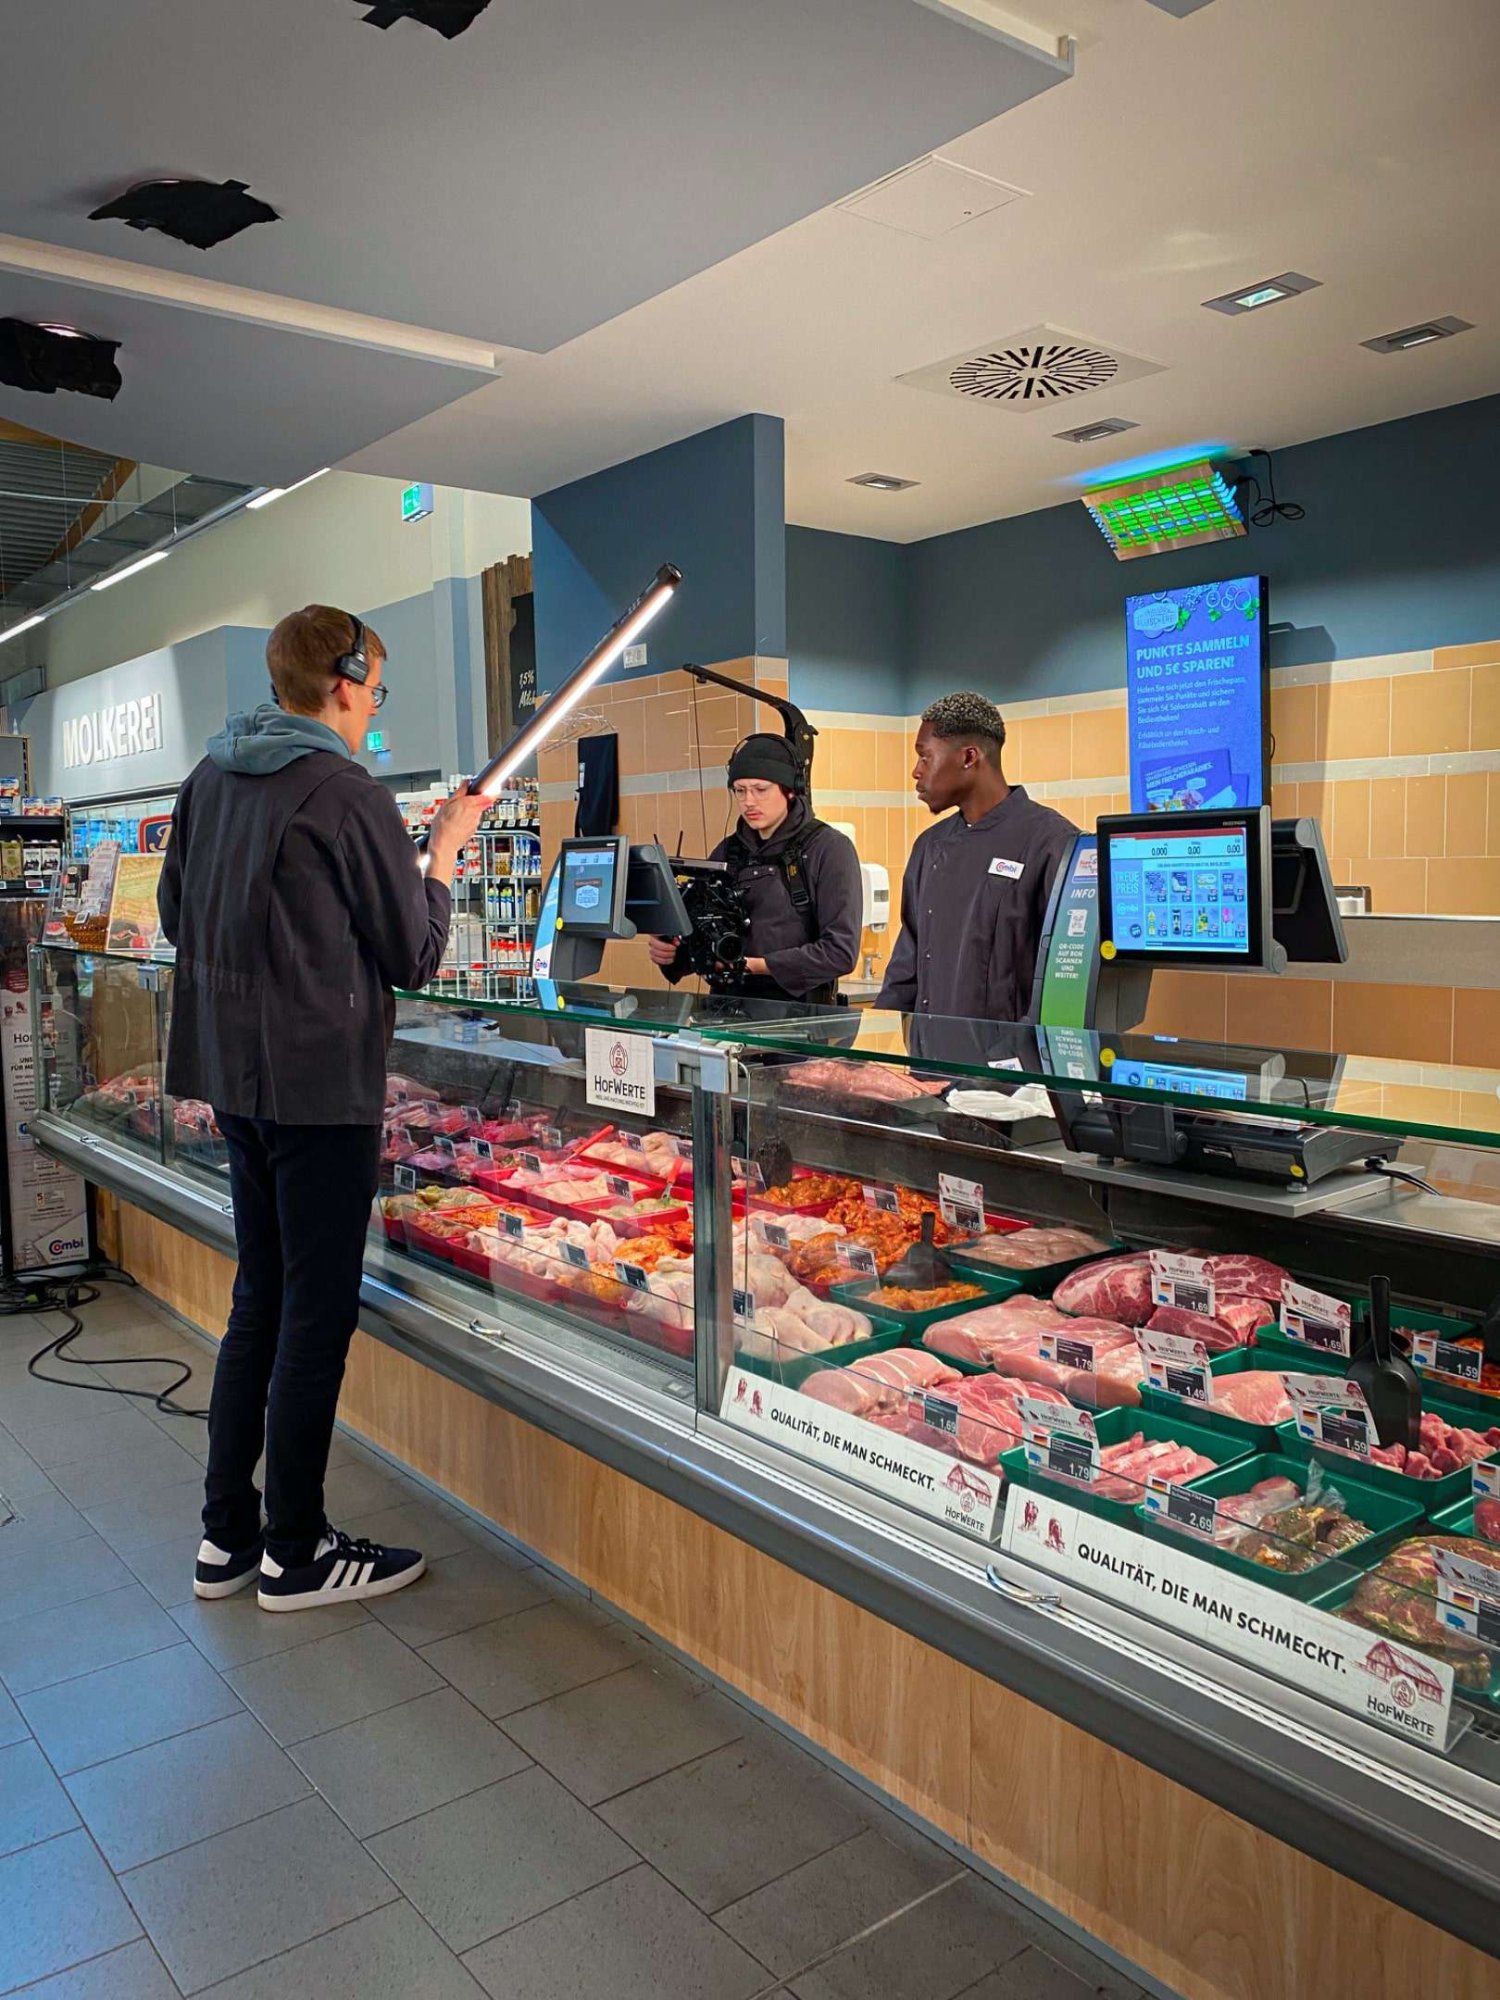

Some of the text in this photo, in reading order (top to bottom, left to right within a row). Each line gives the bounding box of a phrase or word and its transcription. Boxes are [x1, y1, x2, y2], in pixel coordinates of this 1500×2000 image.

[1136, 635, 1250, 661] PUNKTE SAMMELN
[1137, 655, 1235, 679] UND 5€ SPAREN!
[63, 694, 163, 769] MOLKEREI
[1151, 847, 1168, 856] 0.000
[1188, 846, 1201, 855] 0.00
[1226, 844, 1241, 854] 0.00
[1070, 888, 1096, 899] INFO
[49, 1237, 84, 1256] Combi
[770, 1408, 936, 1492] QUALITÄT, DIE MAN SCHMECKT.
[1078, 1543, 1347, 1674] QUALITÄT, DIE MAN SCHMECKT.
